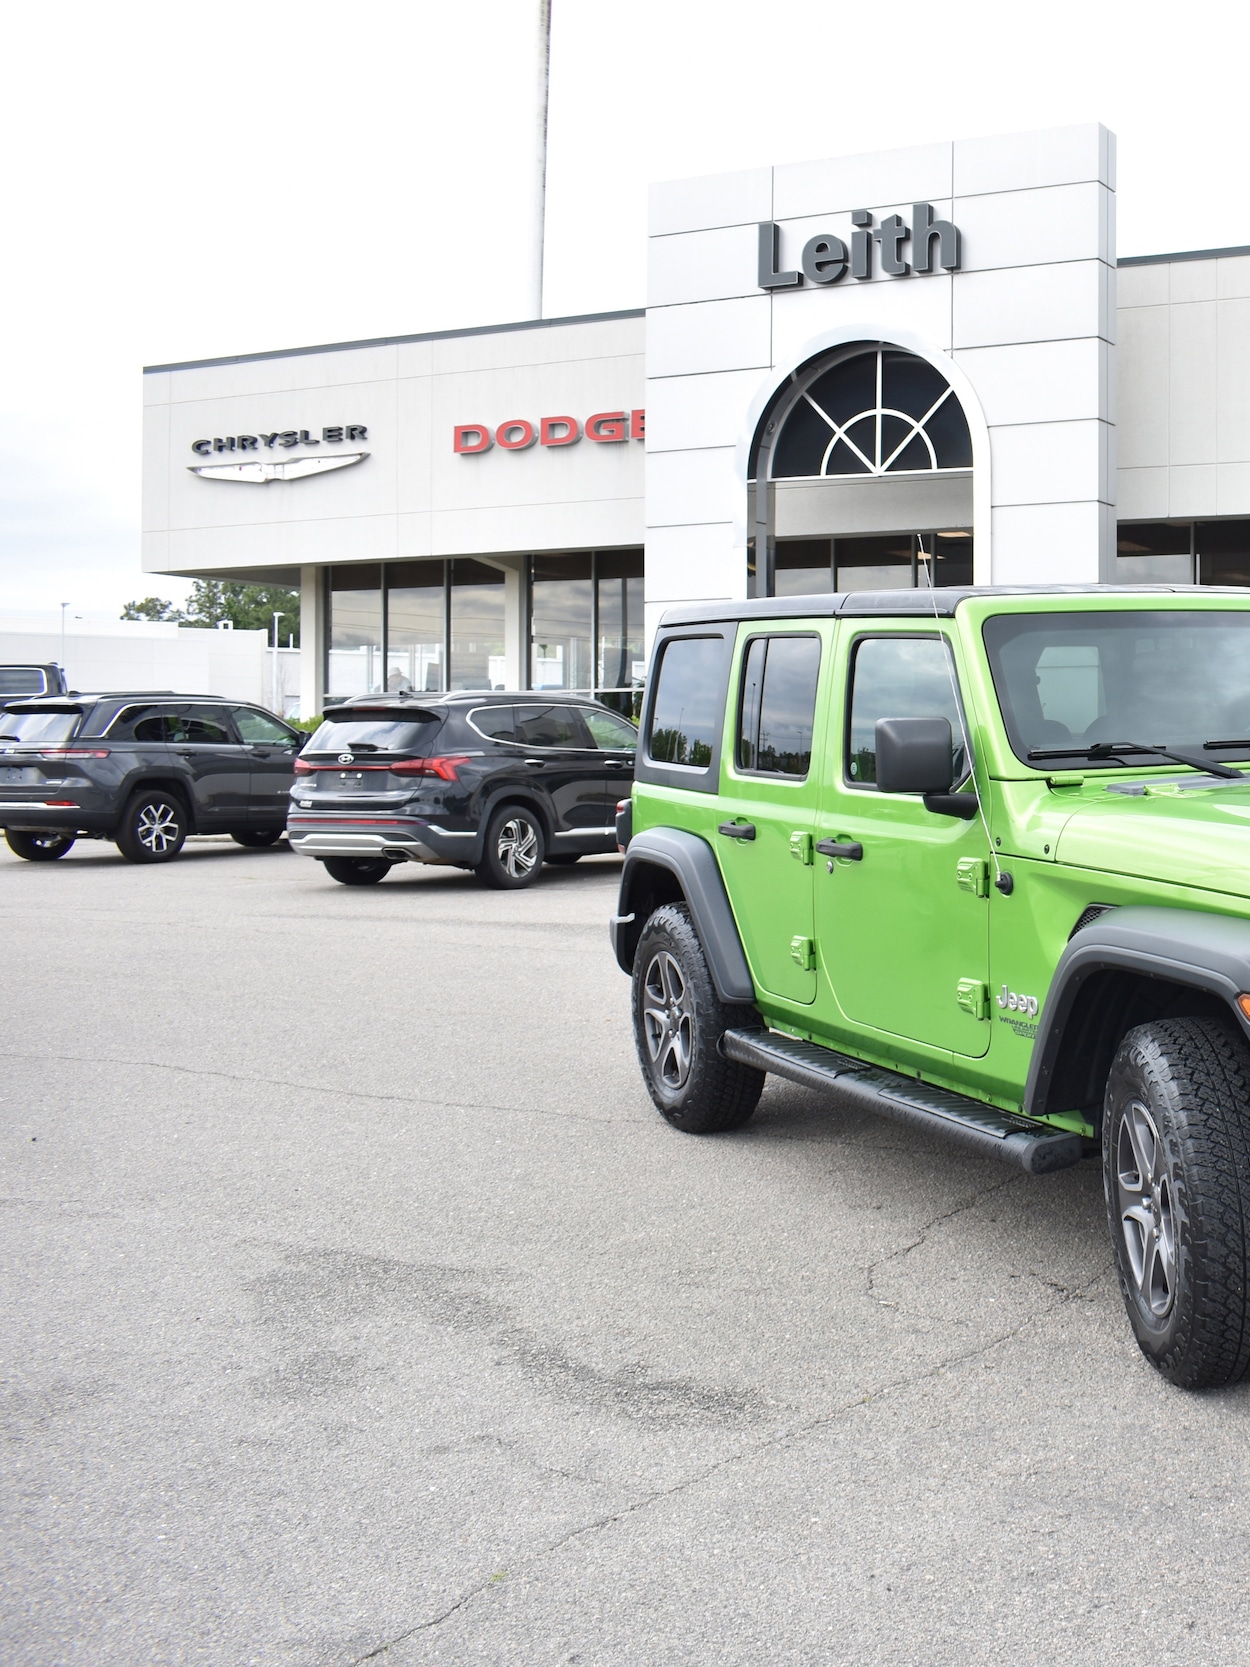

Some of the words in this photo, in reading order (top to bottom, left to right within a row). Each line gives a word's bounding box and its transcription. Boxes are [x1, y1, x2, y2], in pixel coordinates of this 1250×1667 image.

[757, 202, 962, 291] Leith
[191, 424, 368, 455] CHRYSLER
[995, 984, 1039, 1020] Jeep
